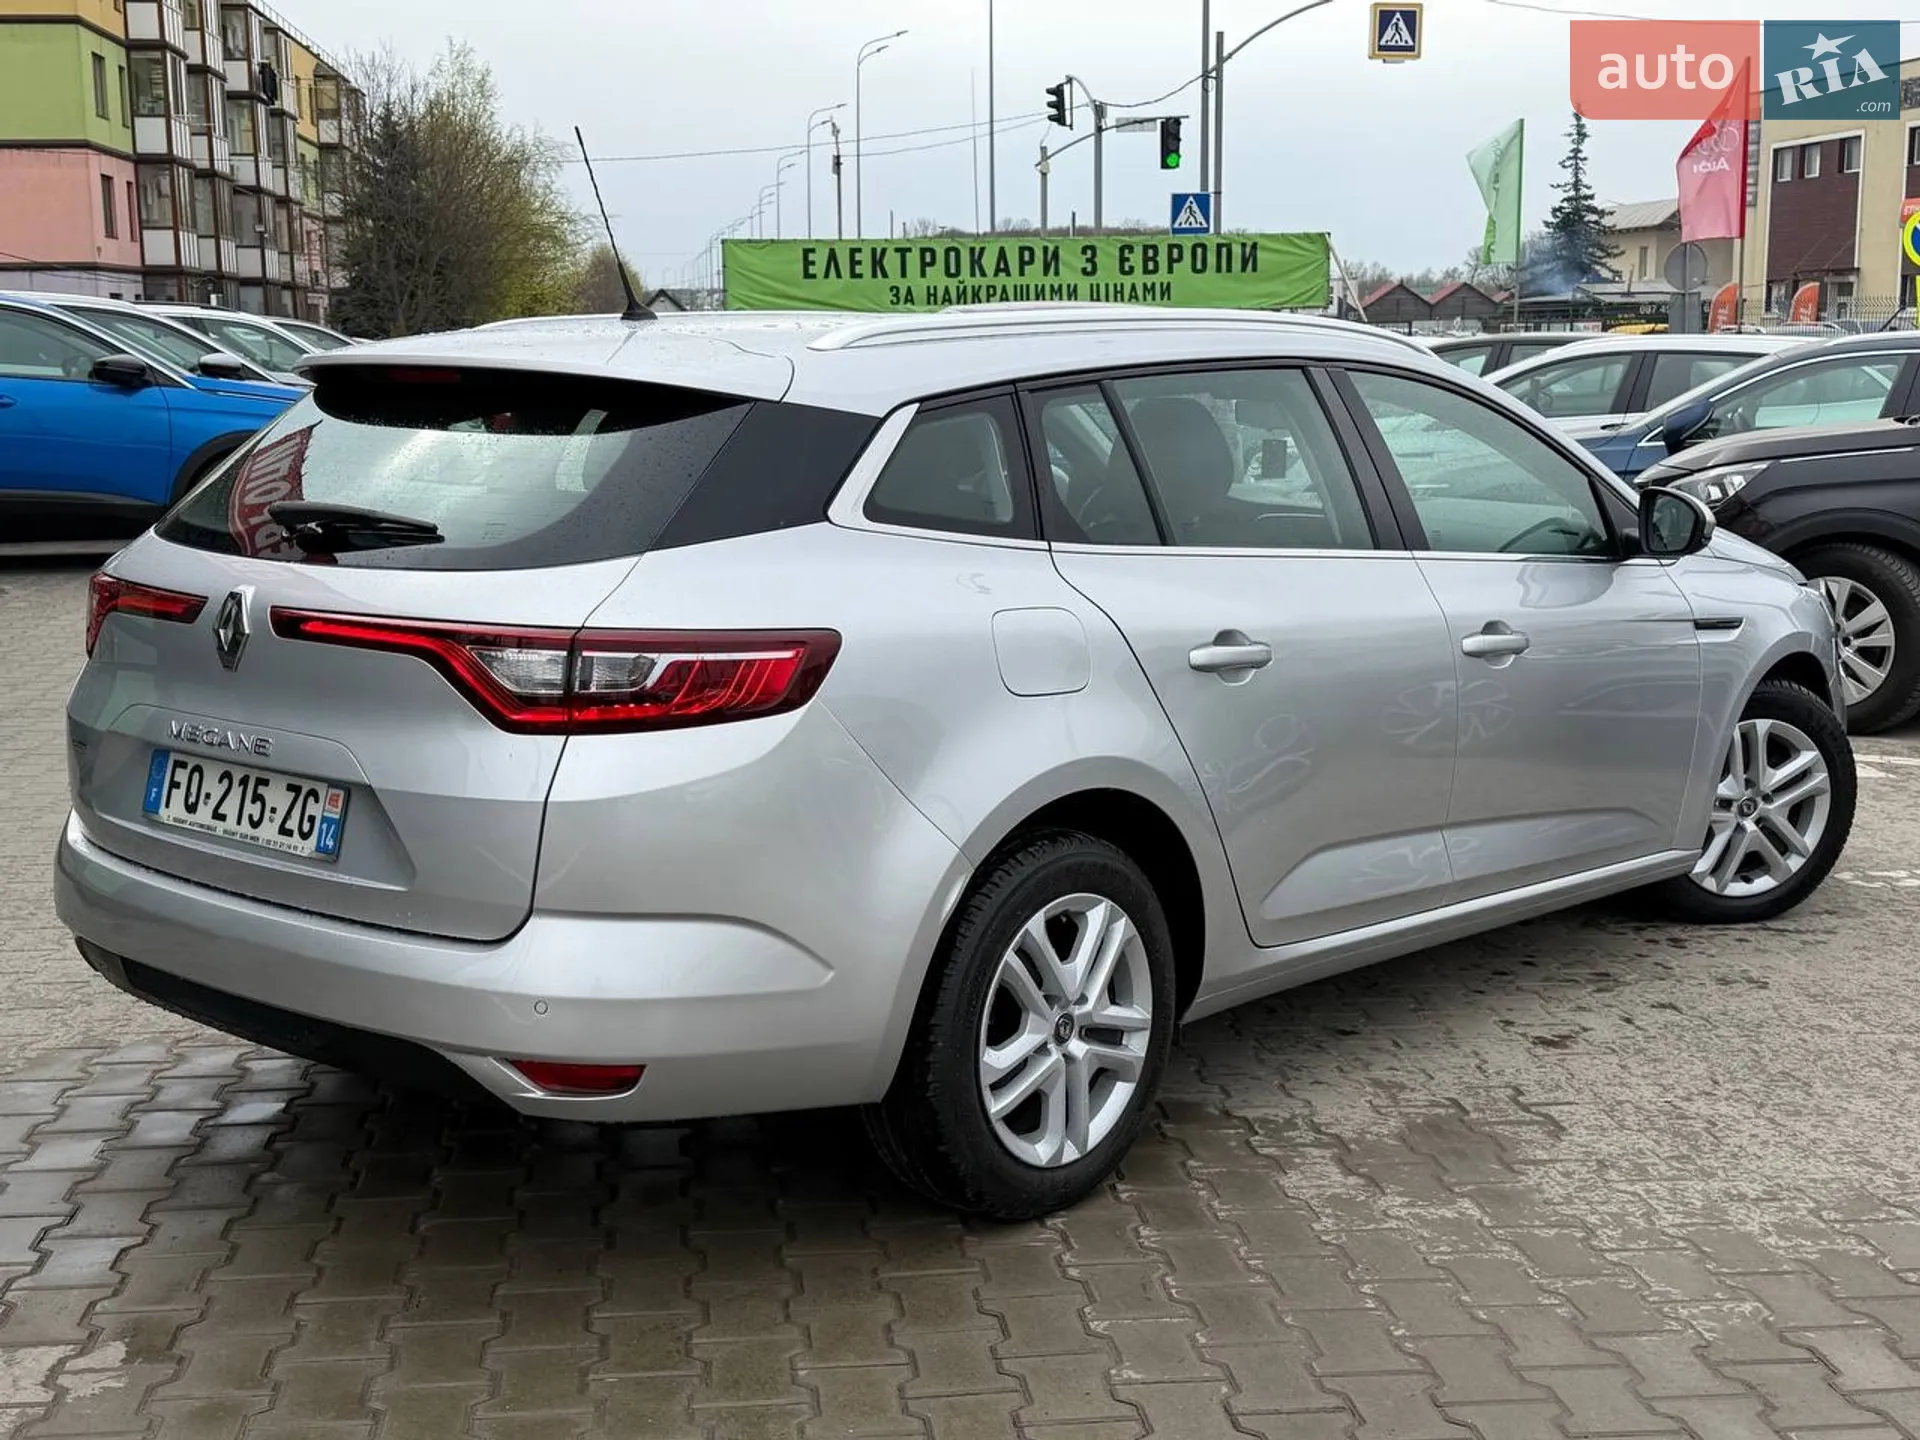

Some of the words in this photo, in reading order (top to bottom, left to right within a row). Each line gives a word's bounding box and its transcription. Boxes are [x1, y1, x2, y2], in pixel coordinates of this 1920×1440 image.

[802, 245, 1061, 279] ЕЛЕКТРОКАРИ
[1080, 244, 1098, 277] З
[1118, 242, 1258, 276] ЄВРОПИ
[889, 285, 916, 306] ЗА
[168, 720, 273, 757] MEGANE
[319, 821, 335, 849] 14
